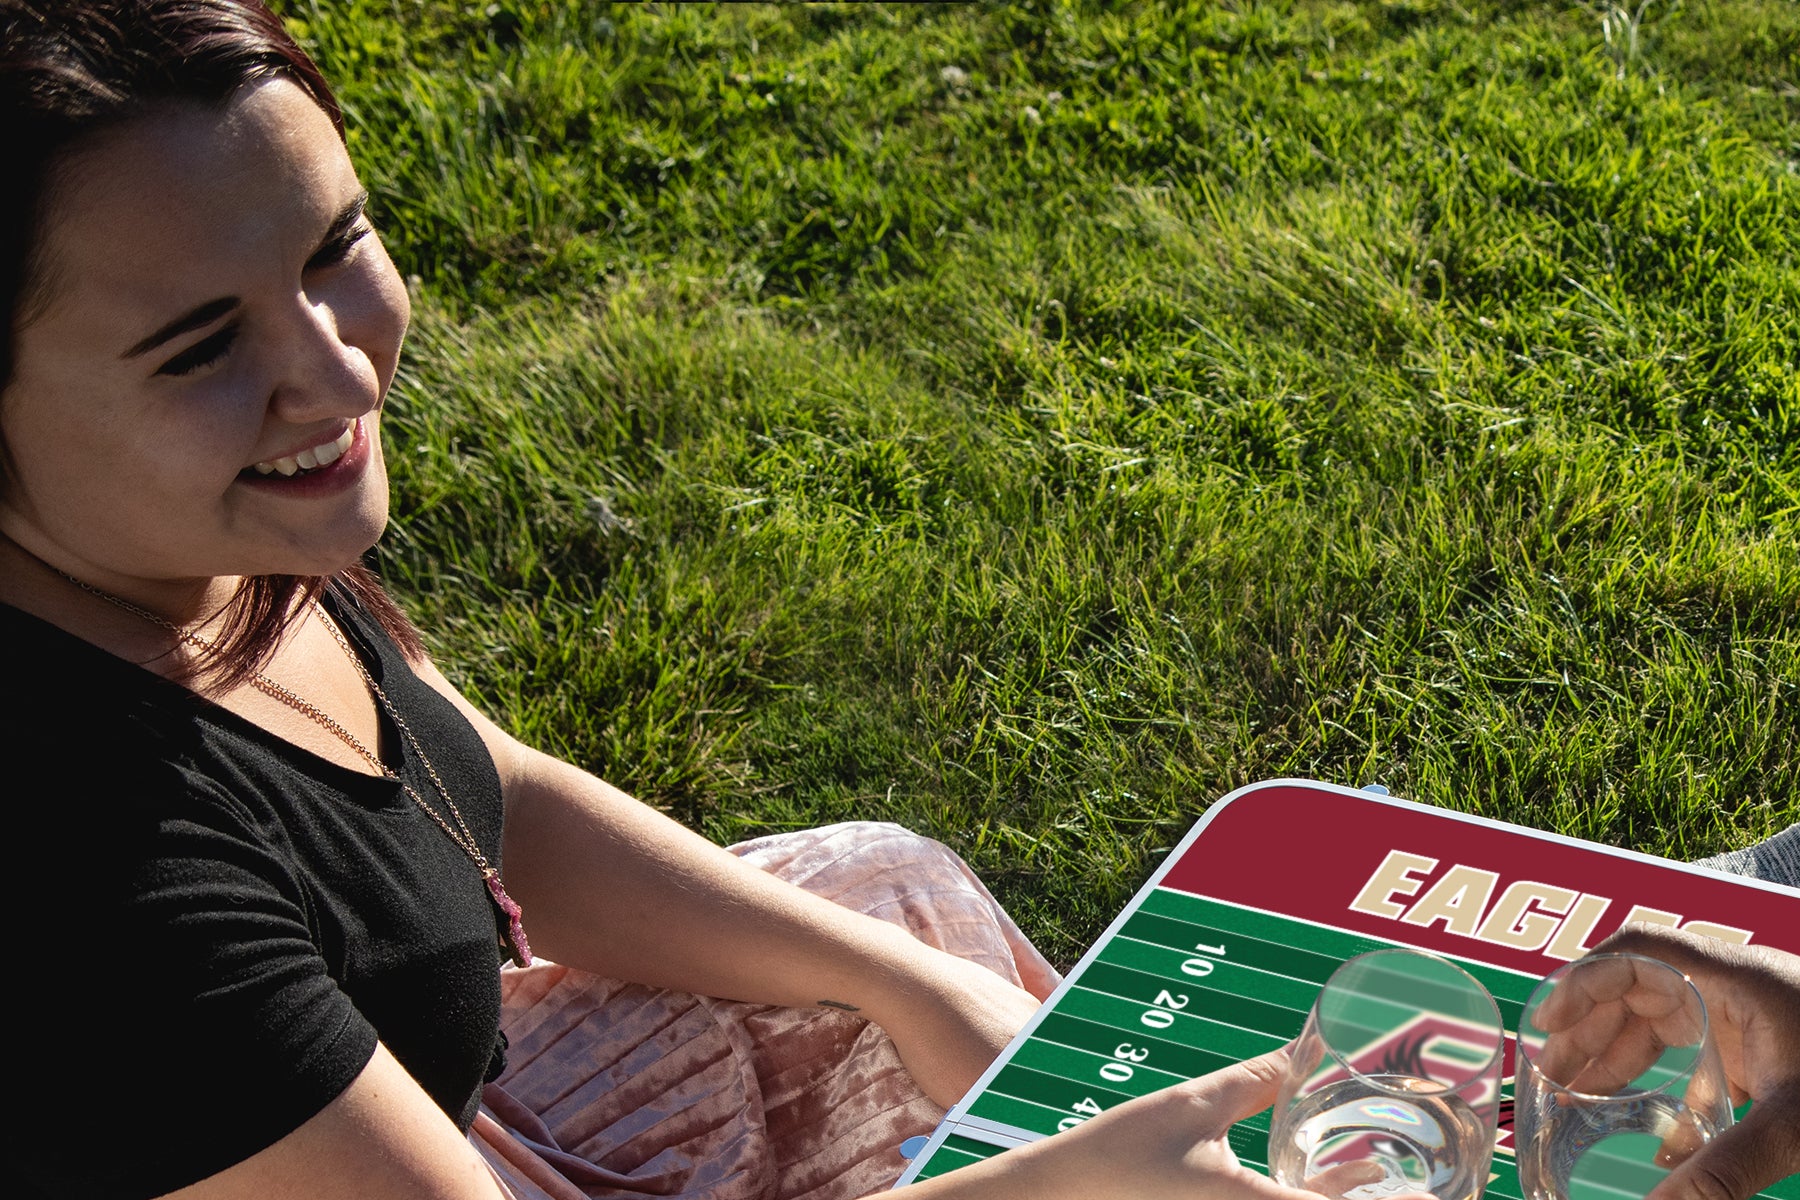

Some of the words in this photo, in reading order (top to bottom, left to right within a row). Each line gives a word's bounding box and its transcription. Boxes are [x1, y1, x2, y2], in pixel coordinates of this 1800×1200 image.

[1347, 849, 1755, 962] EAGL
[1181, 943, 1227, 977] 10
[1140, 989, 1190, 1029] 20
[1099, 1042, 1150, 1082] 30
